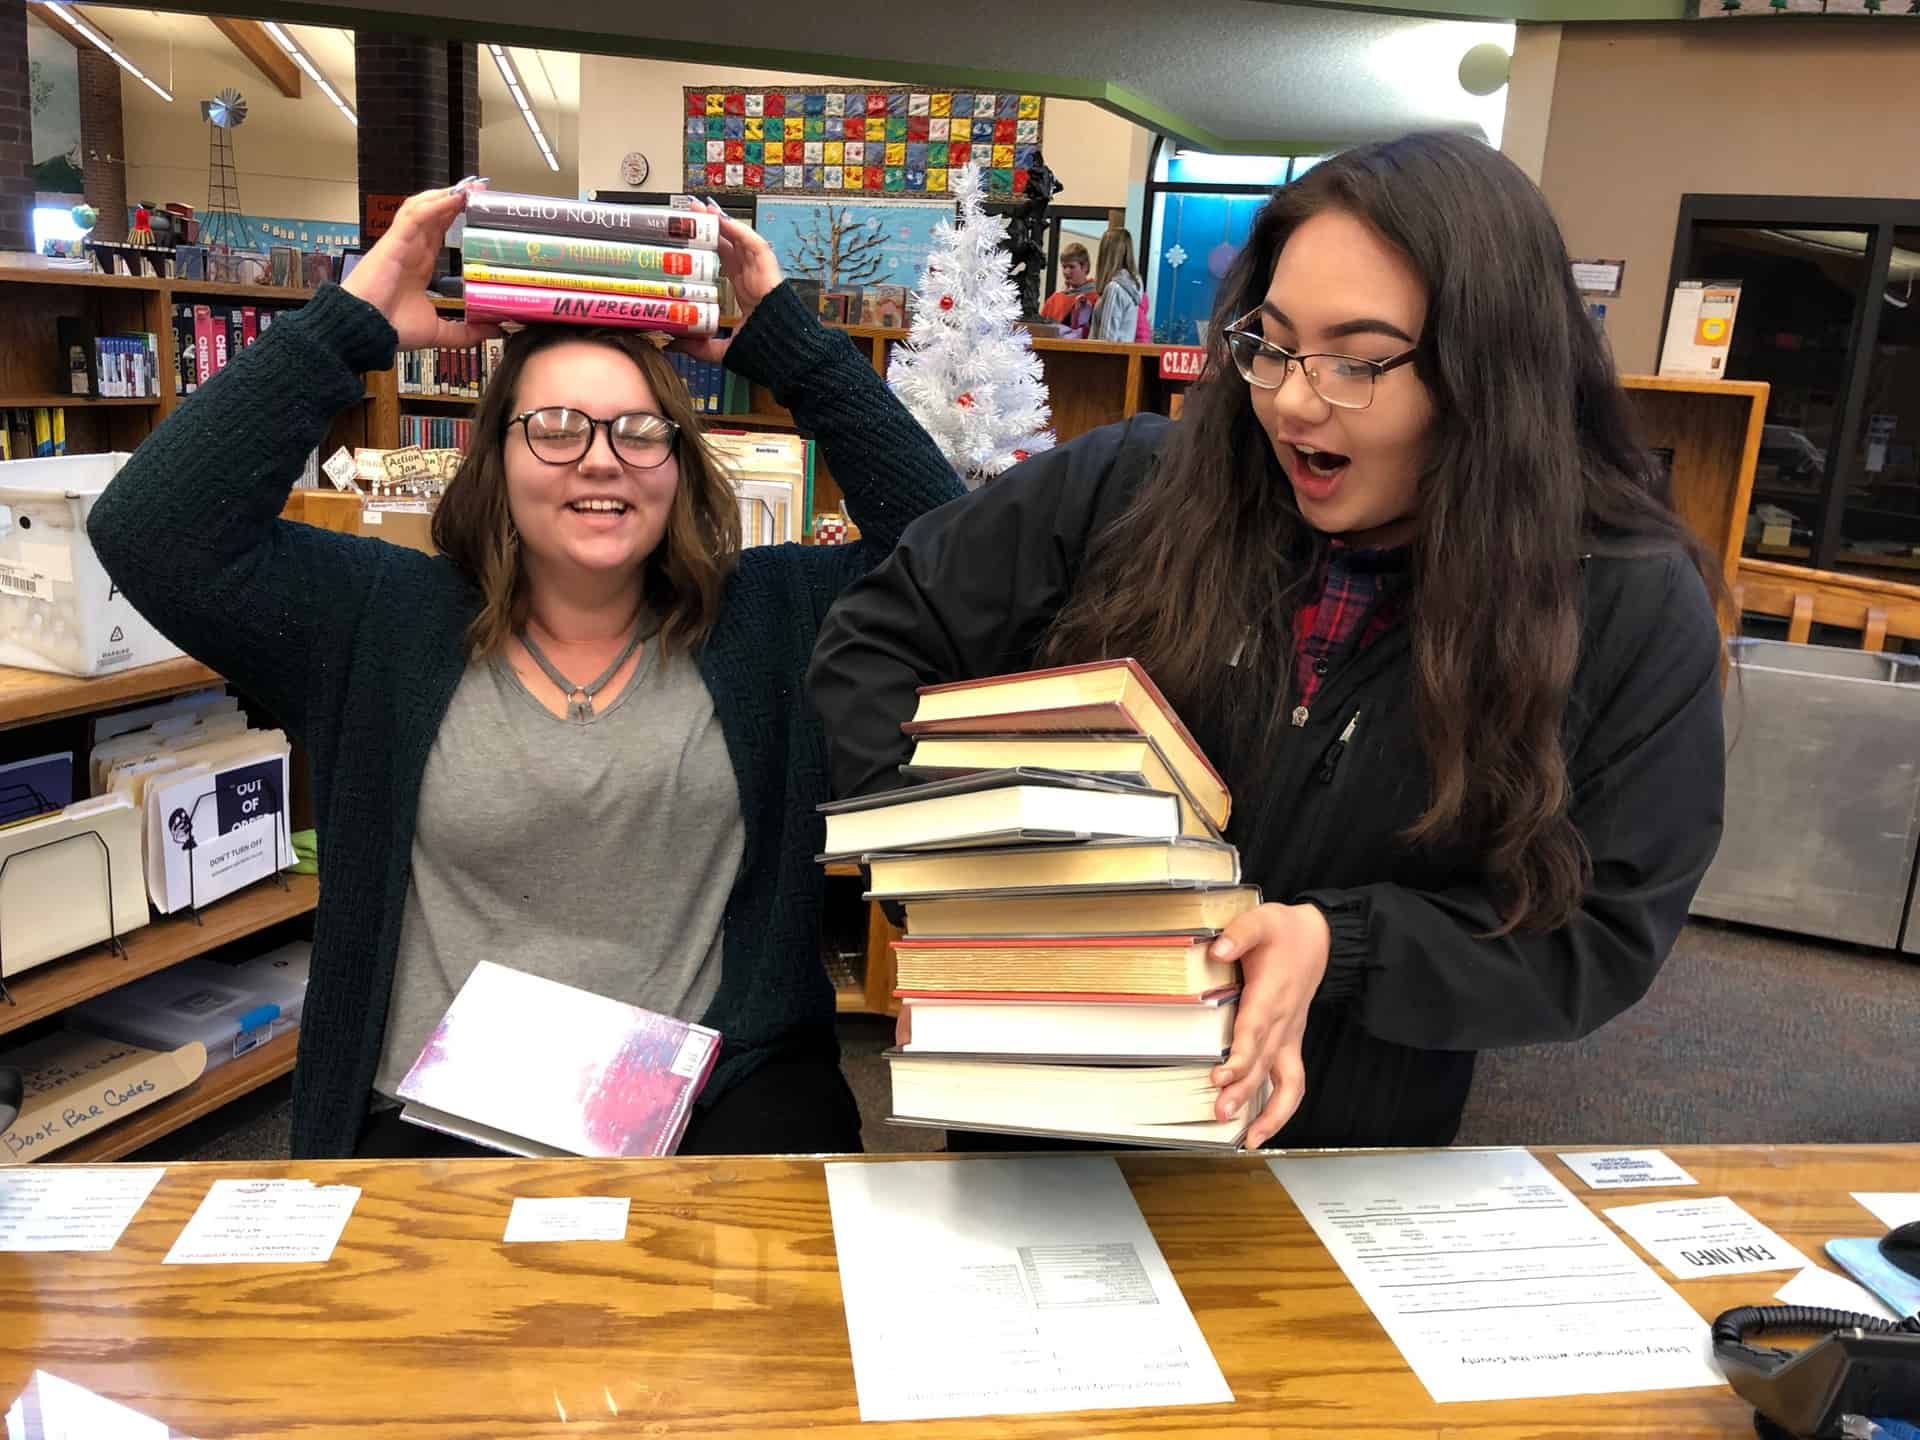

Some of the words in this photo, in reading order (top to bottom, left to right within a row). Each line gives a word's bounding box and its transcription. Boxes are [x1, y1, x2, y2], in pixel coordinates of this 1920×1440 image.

[506, 203, 558, 220] ECHO
[564, 206, 631, 228] NORTH
[198, 336, 211, 383] CHILTO
[389, 453, 421, 467] Action
[237, 779, 263, 796] OUT
[242, 797, 259, 814] OF
[1679, 1248, 1732, 1267] INFO
[1727, 1244, 1777, 1263] FAX
